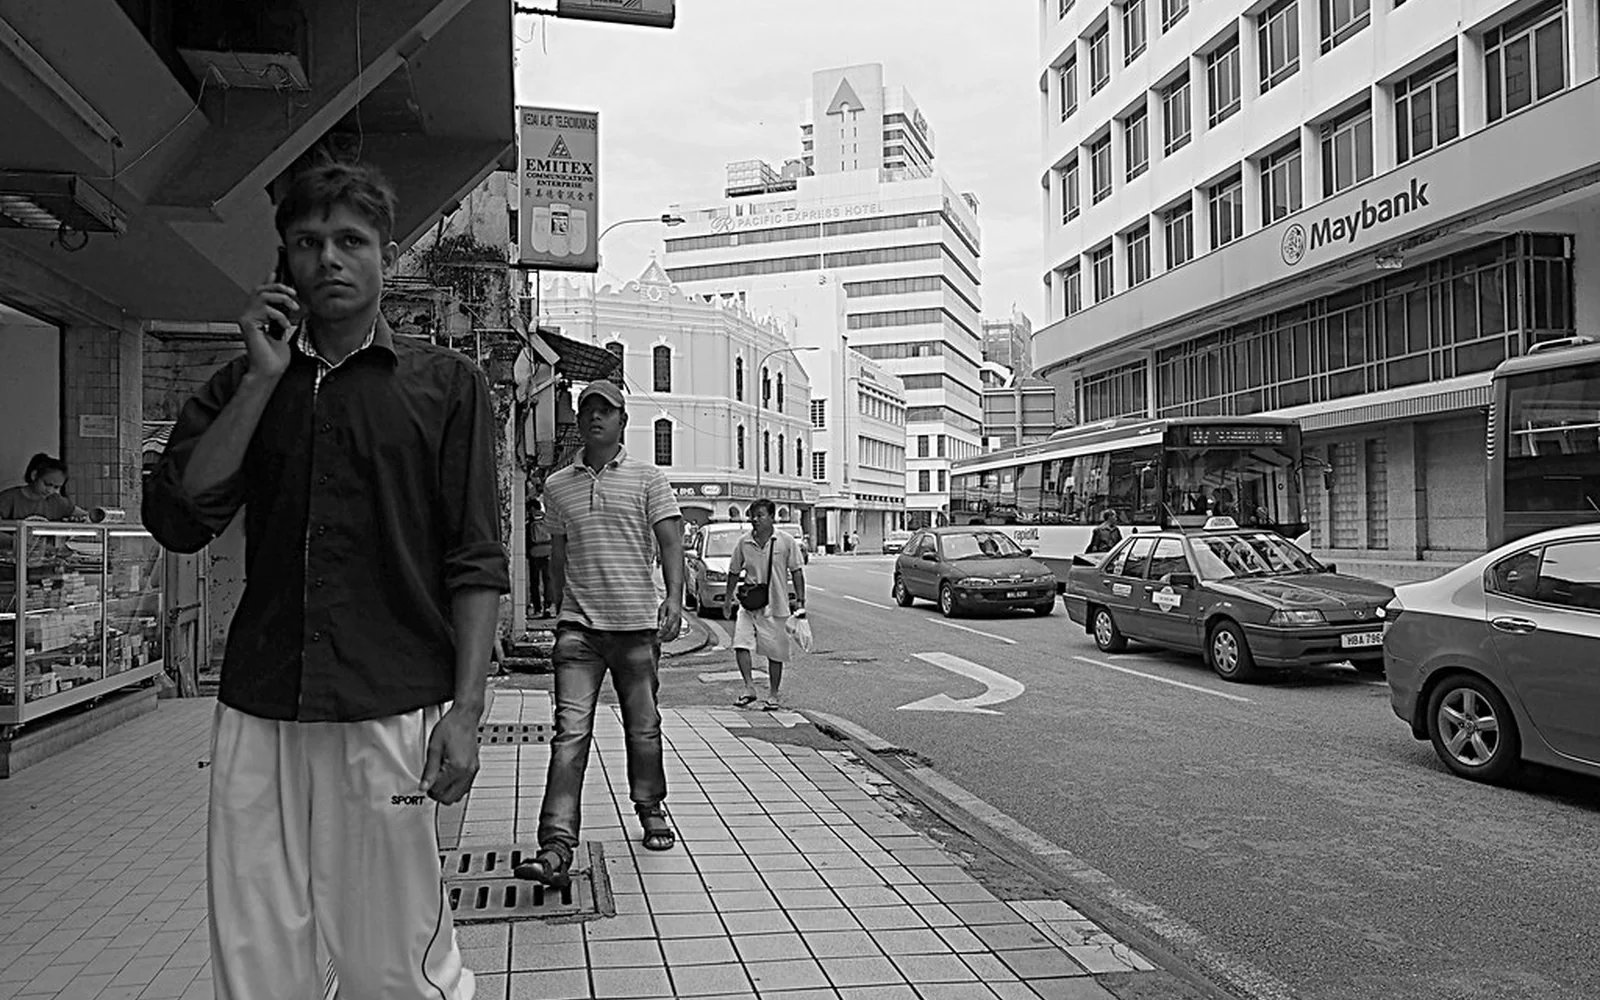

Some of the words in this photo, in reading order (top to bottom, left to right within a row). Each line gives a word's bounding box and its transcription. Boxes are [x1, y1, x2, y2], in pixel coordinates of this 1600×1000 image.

[525, 158, 593, 176] EMITEX
[536, 180, 583, 189] ENTERPRISE
[738, 212, 783, 228] PACIFIC
[786, 207, 840, 222] EXPRESS
[845, 203, 885, 216] HOTEL
[1310, 178, 1429, 251] Maybank
[391, 795, 426, 806] SPORT
